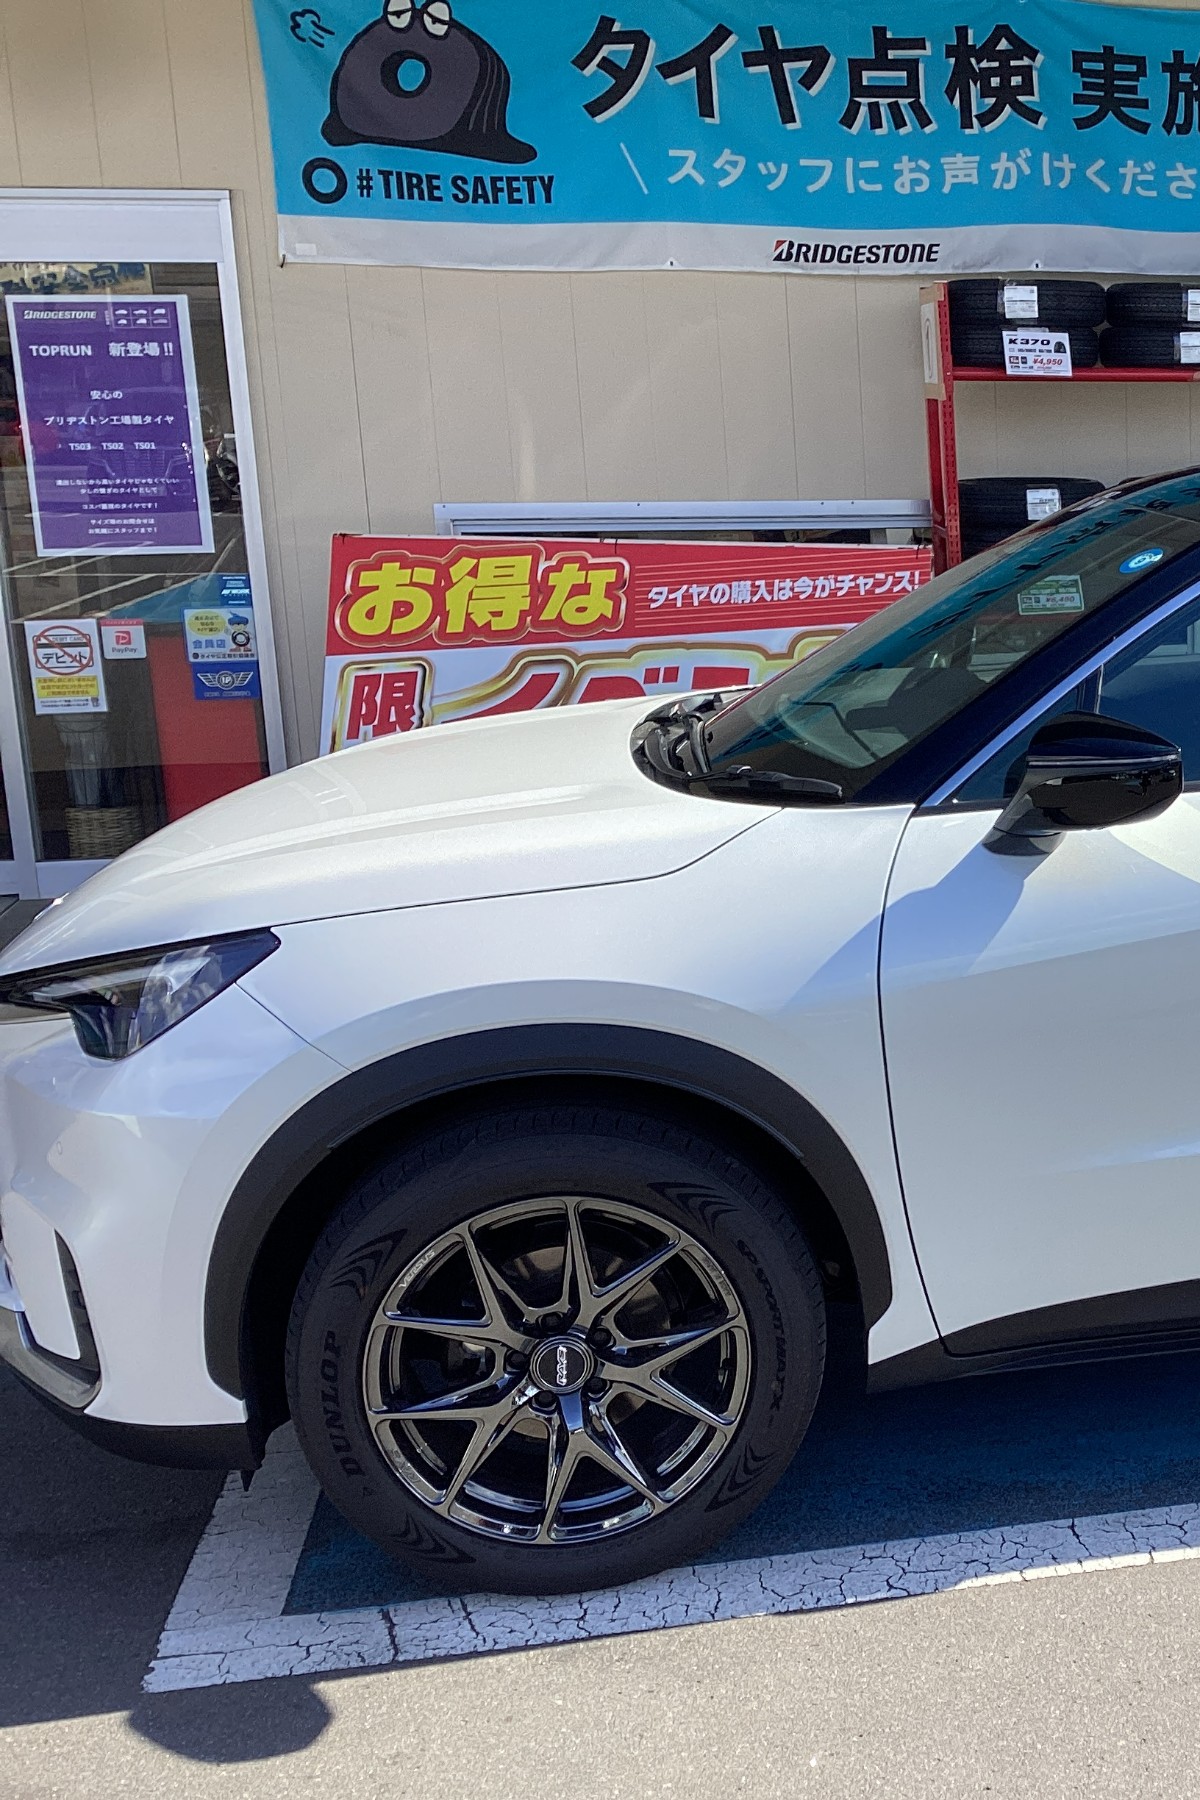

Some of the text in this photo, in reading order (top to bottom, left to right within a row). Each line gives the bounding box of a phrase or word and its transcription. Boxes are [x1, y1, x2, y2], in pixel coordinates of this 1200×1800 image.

[570, 14, 1046, 136] タイヤ点検
[451, 175, 555, 205] SAFETY
[772, 239, 940, 264] BRIDGESTONE
[23, 310, 97, 319] BRIDGESTONE
[29, 345, 92, 357] TOPRUN
[1008, 338, 1051, 346] K370
[1033, 357, 1063, 366] ¥4,950
[90, 390, 123, 400] 安心の
[69, 442, 156, 450] TS03 TS02 TS01
[347, 555, 920, 634] お得な タイヤの購入は今がチャンス!
[192, 639, 226, 649] 会員店
[346, 670, 418, 740] 限
[398, 1249, 437, 1289] VERSUS
[555, 1344, 569, 1387] RAYS
[320, 1330, 367, 1476] DUNLOP
